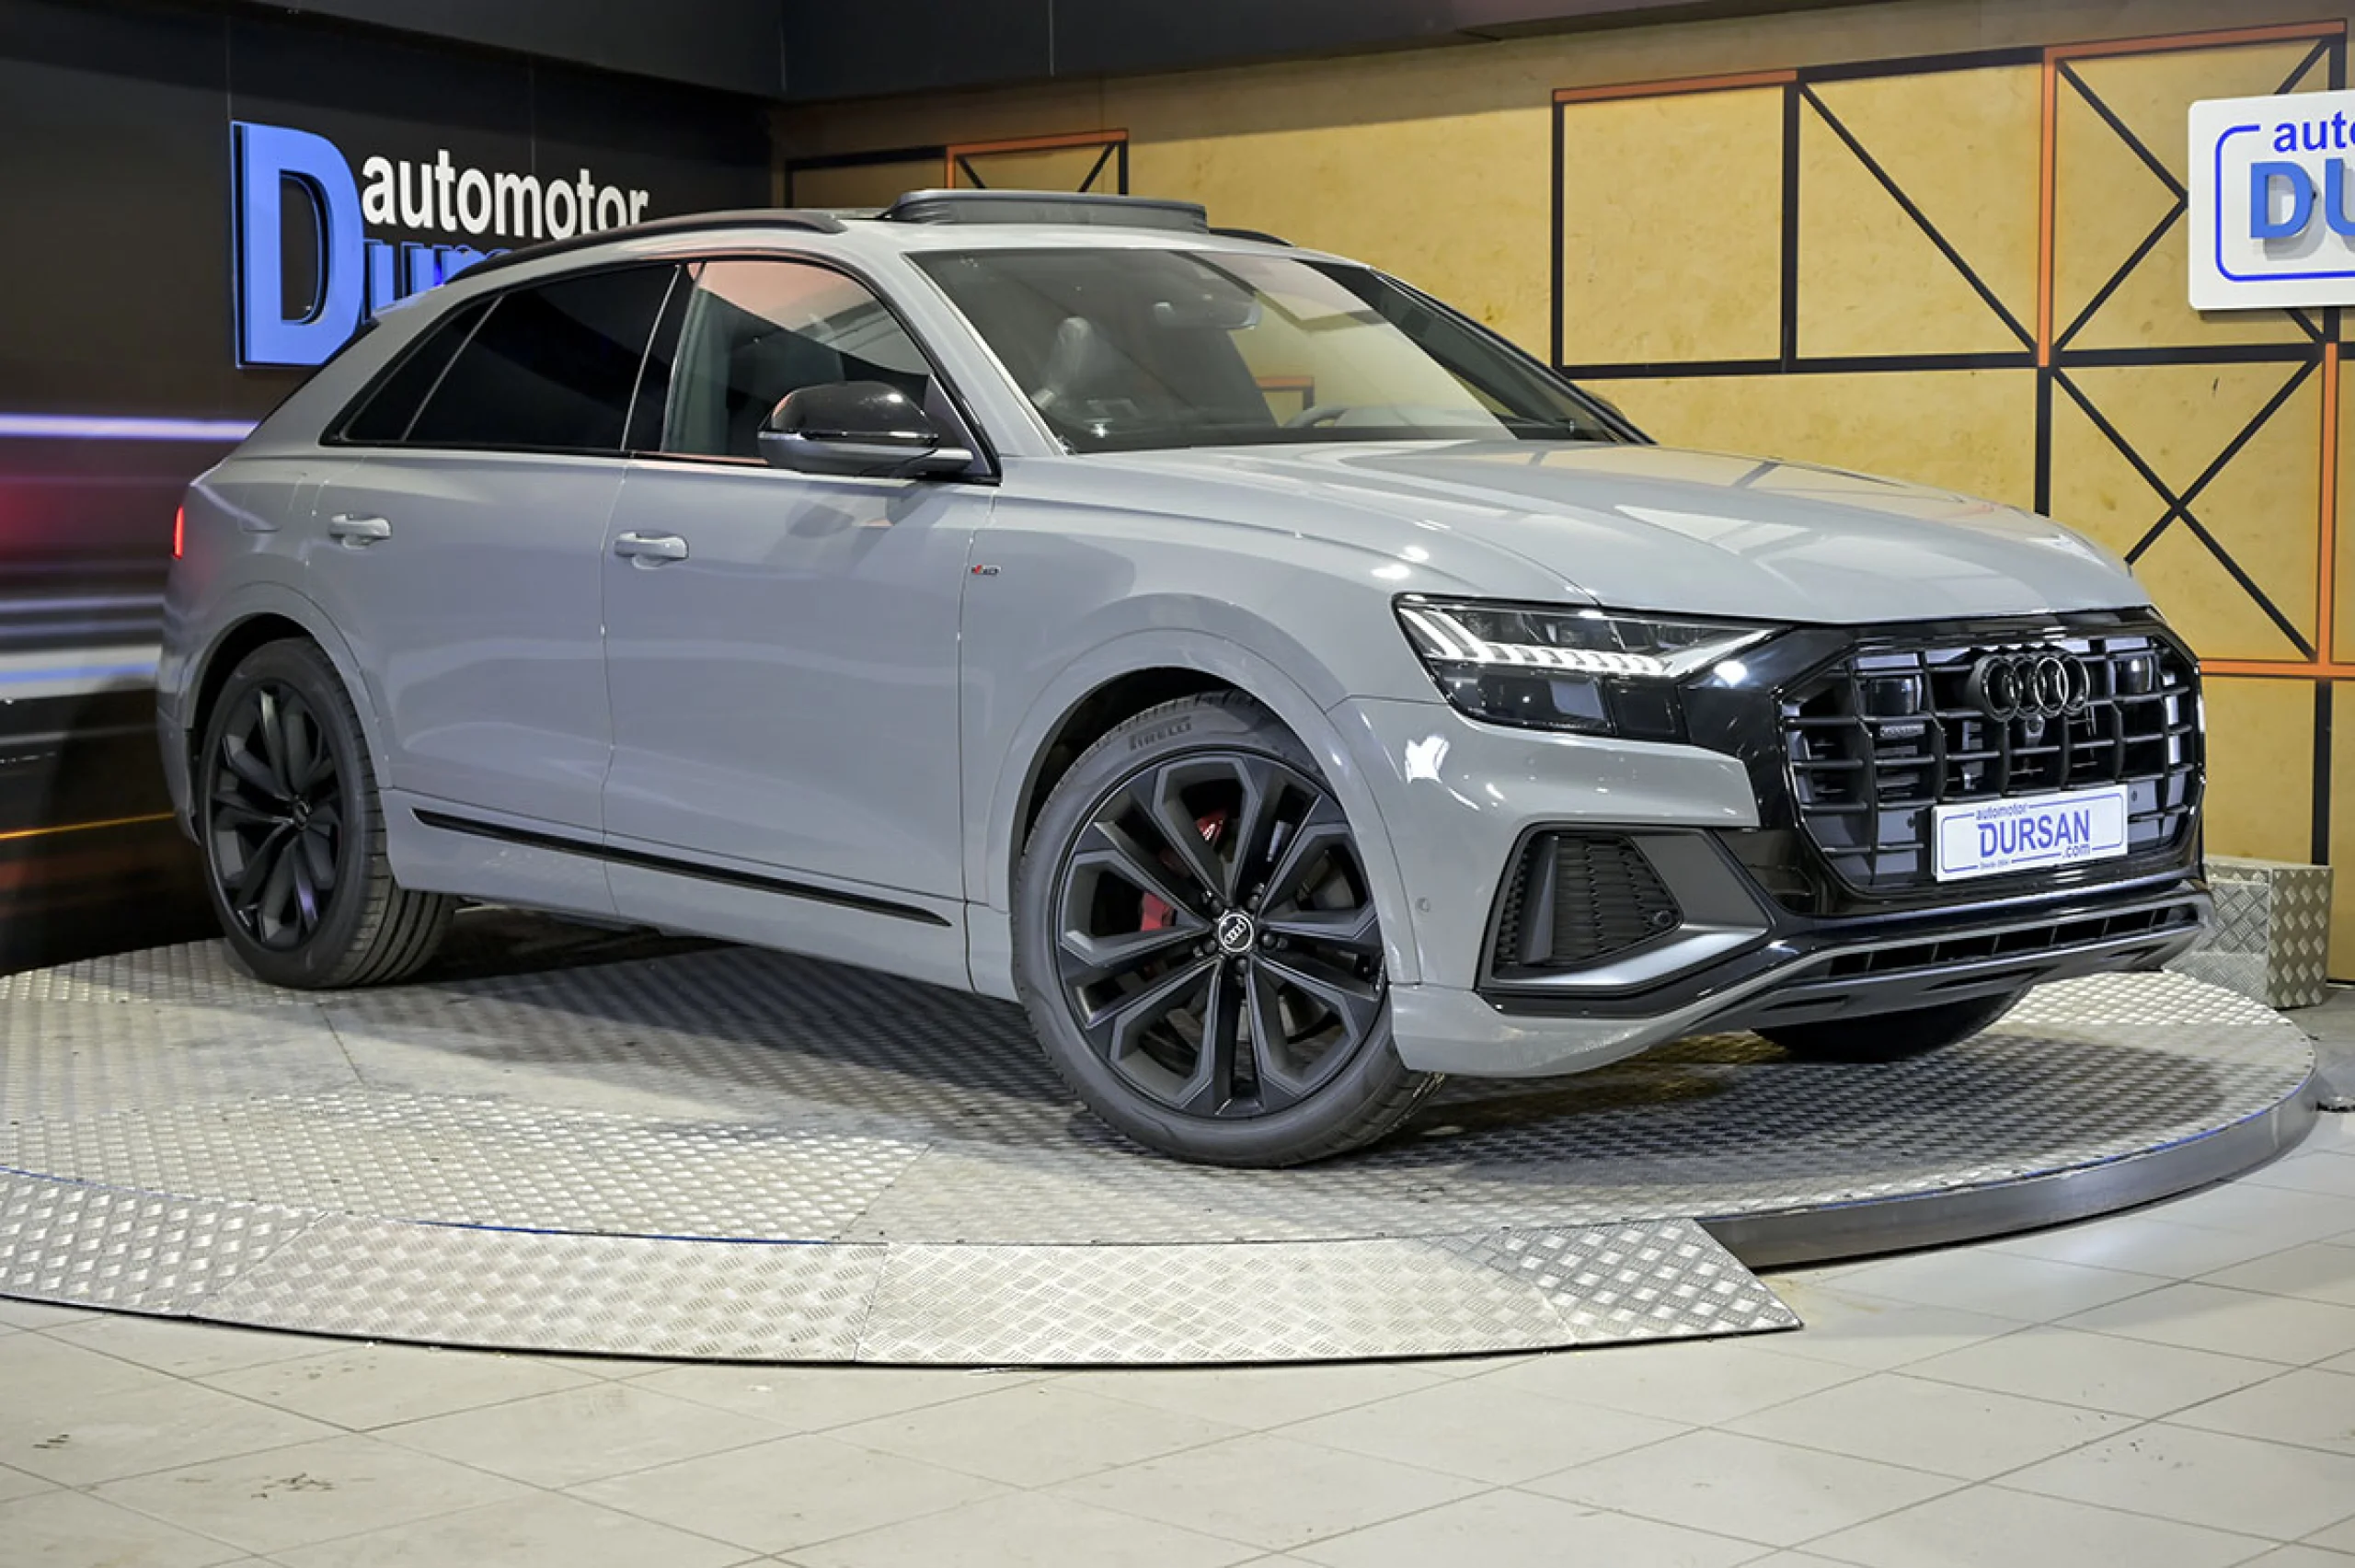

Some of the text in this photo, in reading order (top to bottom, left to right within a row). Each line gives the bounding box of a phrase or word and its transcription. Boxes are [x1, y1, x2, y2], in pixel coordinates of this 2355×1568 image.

[2273, 110, 2355, 154] aut
[362, 148, 649, 240] automotor
[1129, 715, 1192, 751] PIRELLI
[1976, 803, 2028, 820] automotor
[1977, 808, 2091, 858] DURSAN
